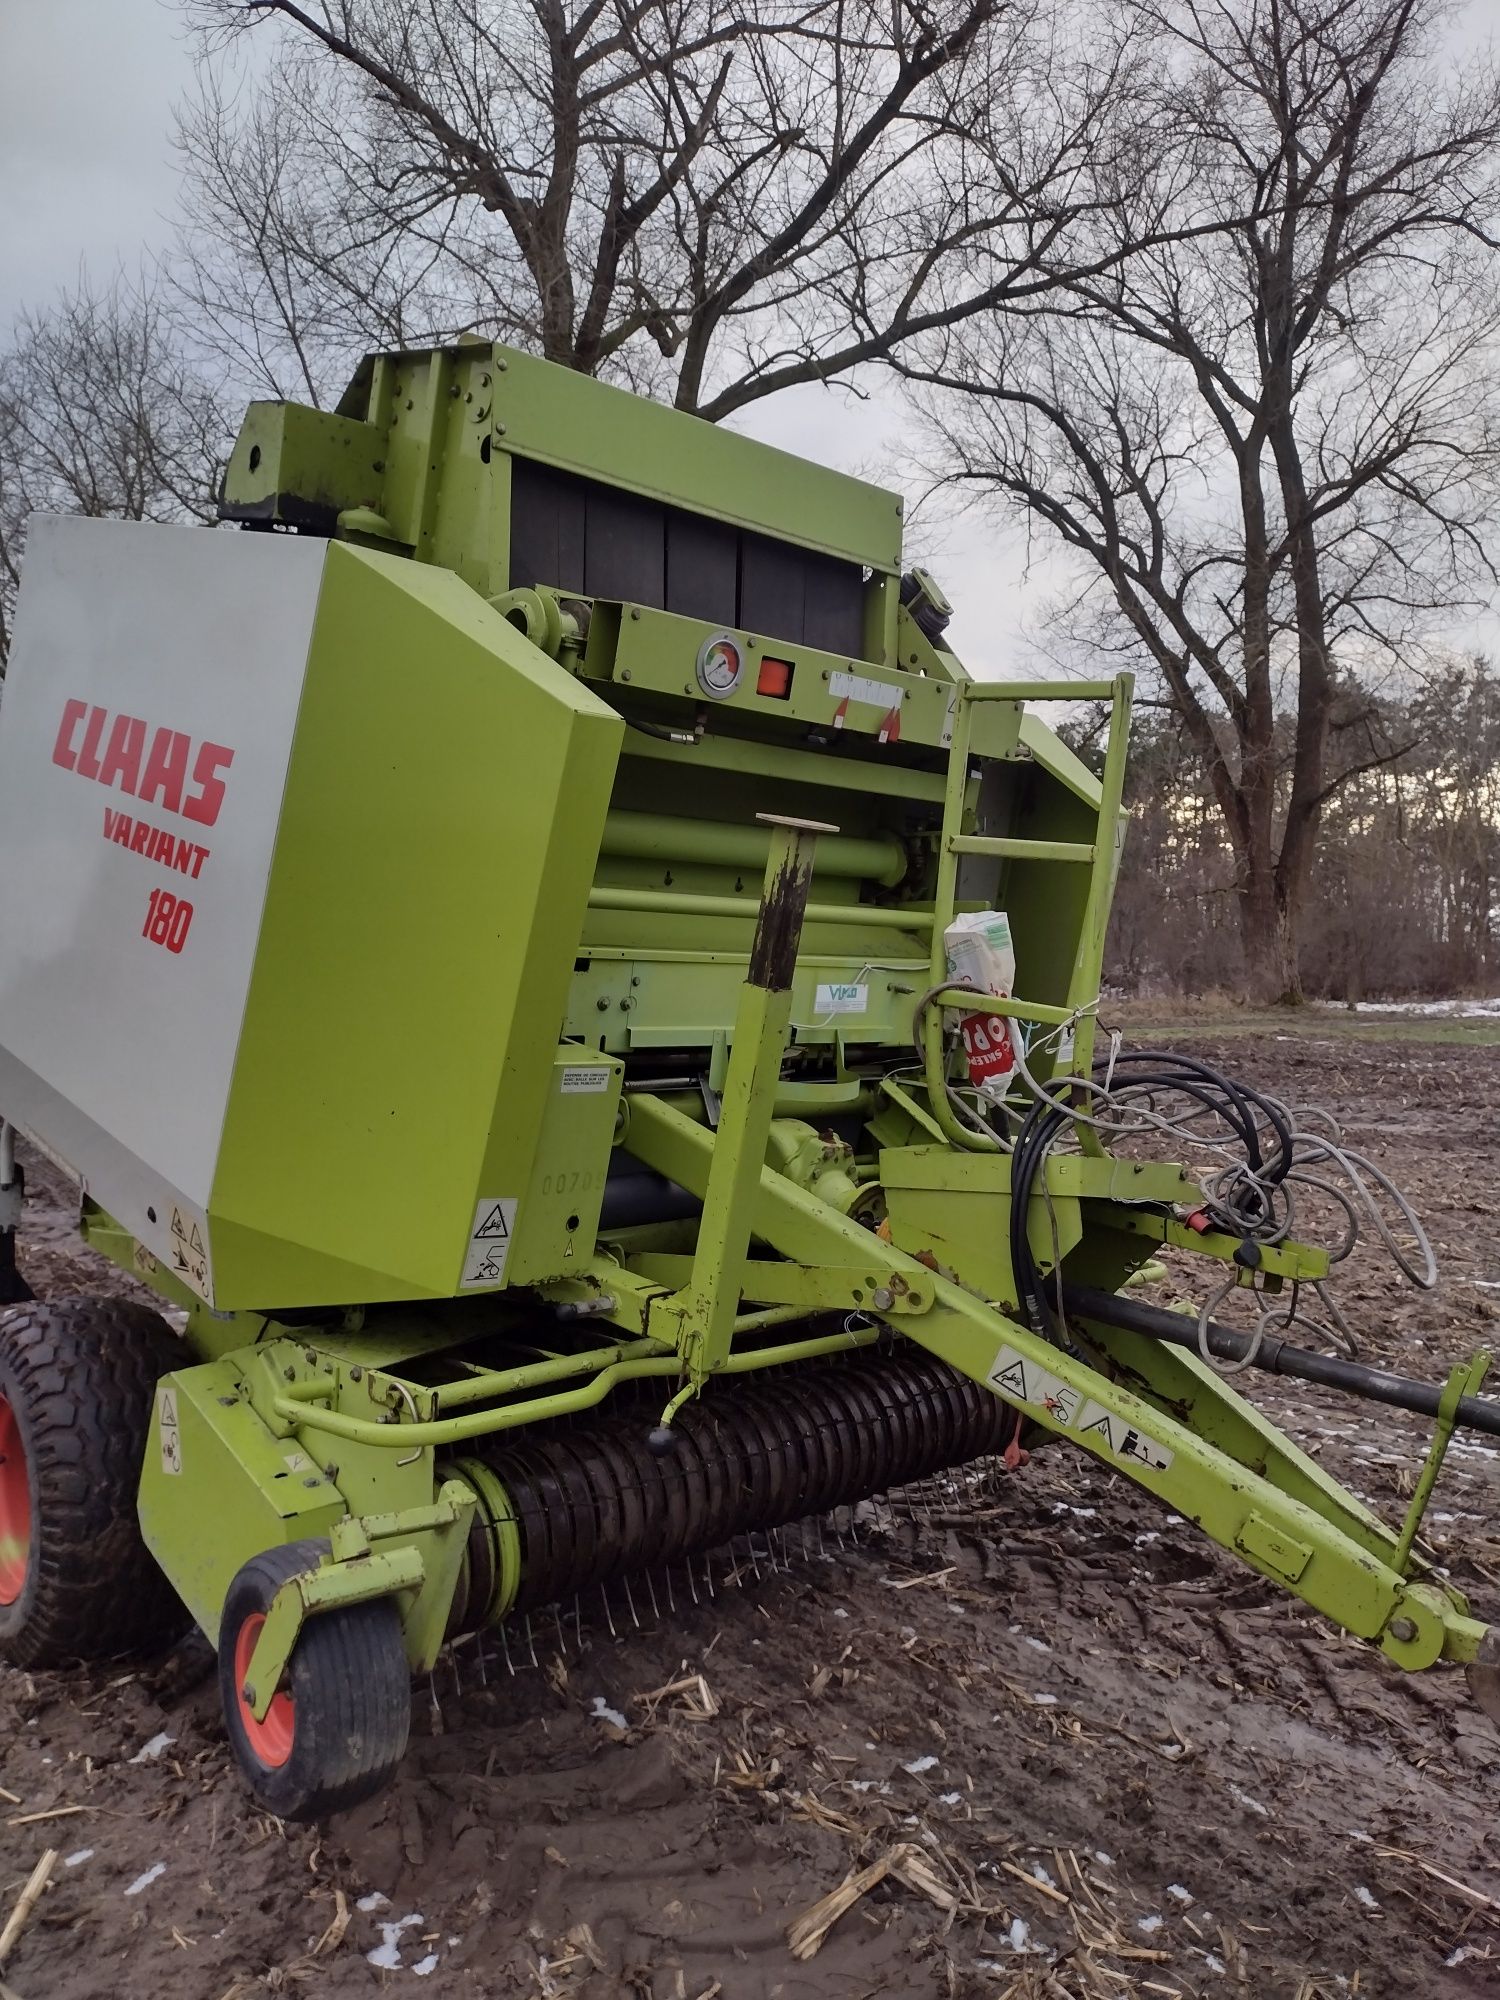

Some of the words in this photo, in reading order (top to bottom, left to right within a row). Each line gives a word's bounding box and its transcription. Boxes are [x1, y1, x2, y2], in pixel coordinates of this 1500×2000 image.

[52, 698, 235, 827] CLAAS
[103, 807, 211, 880] VARIANT
[142, 888, 194, 954] 180
